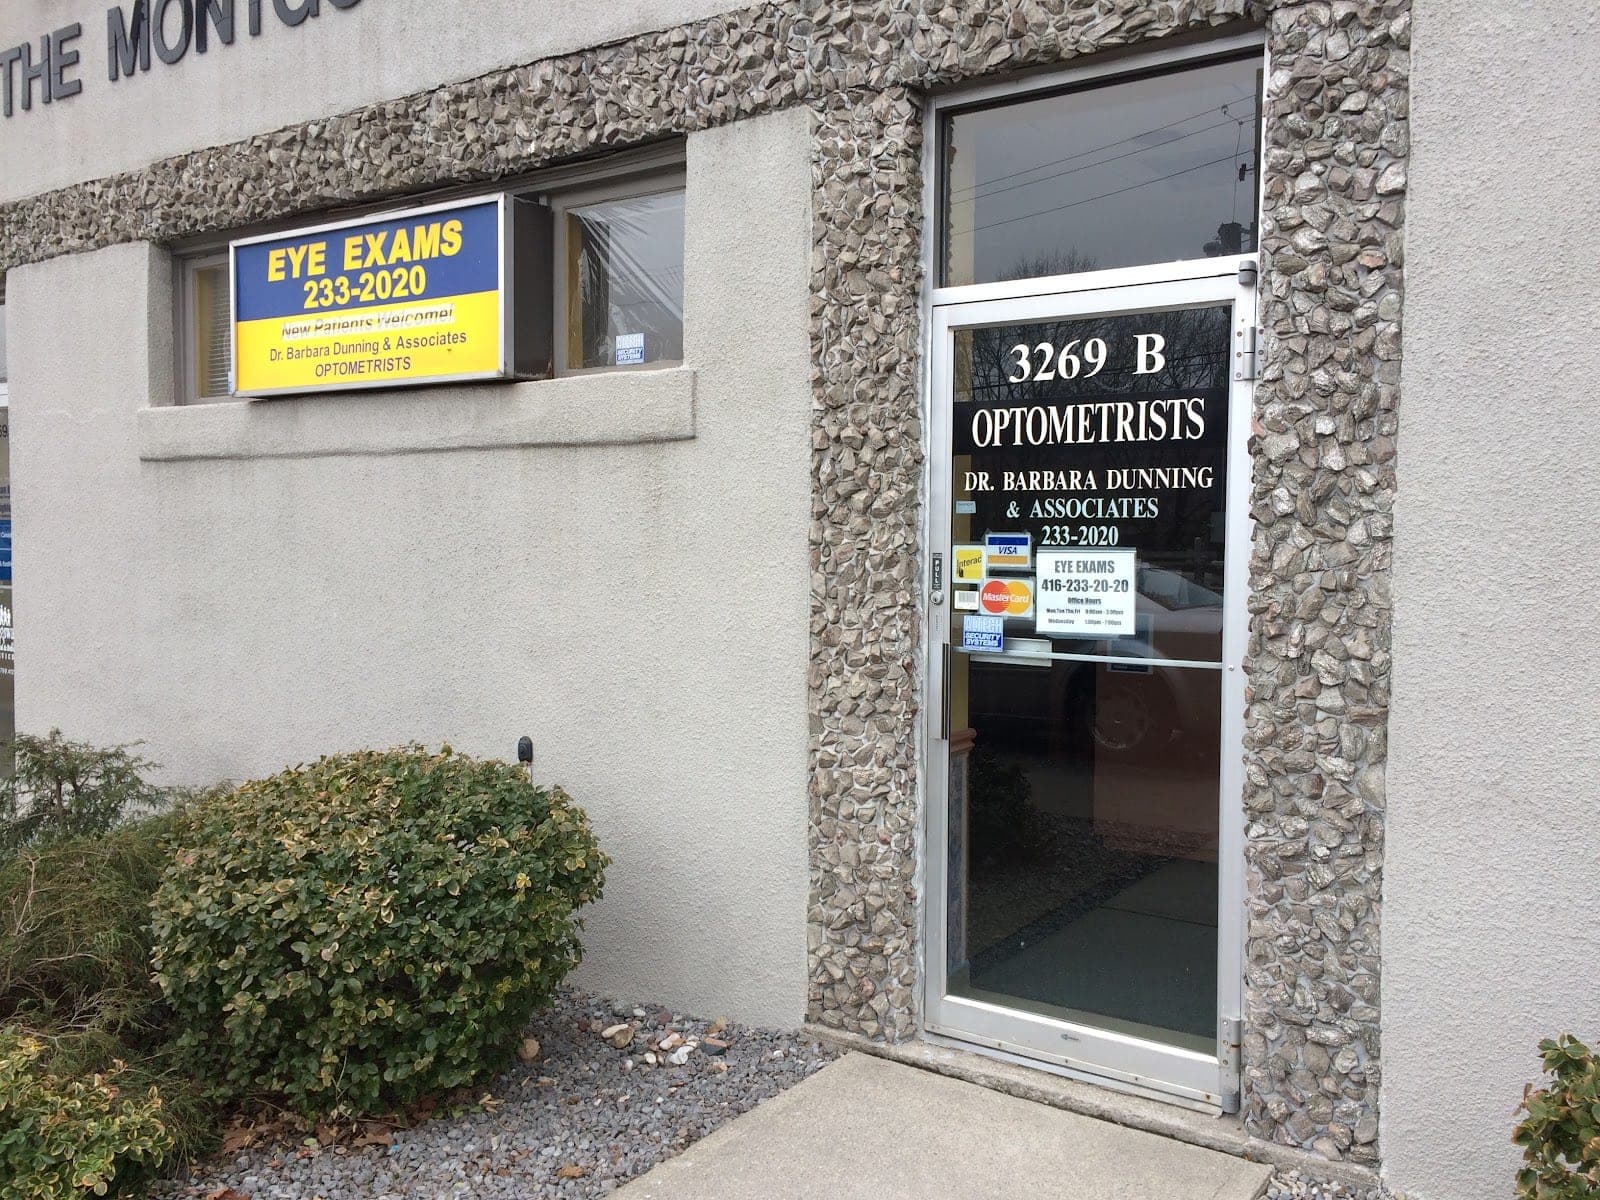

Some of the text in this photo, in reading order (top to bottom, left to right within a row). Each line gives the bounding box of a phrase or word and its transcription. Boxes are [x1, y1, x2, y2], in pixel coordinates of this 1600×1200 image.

[0, 22, 82, 118] THE
[267, 219, 463, 282] EYE EXAMS
[303, 265, 426, 309] 233-2020
[270, 331, 467, 361] Dr. Barbara Dunning & Associates
[315, 356, 411, 377] OPTOMETRISTS
[1008, 333, 1166, 384] 3269 B
[971, 397, 1205, 448] OPTOMETRISTS
[964, 466, 1214, 492] DR. BARBARA DUNNING
[1006, 498, 1159, 519] & ASSOCIATES
[1041, 525, 1119, 546] 233-2020
[998, 546, 1017, 555] VISA
[1054, 560, 1115, 574] EYE EXAMS
[1041, 579, 1129, 593] 416-233-20-20
[982, 592, 1029, 603] MasterCard
[1067, 597, 1102, 606] Office Hours
[965, 633, 1000, 641] SECURITY
